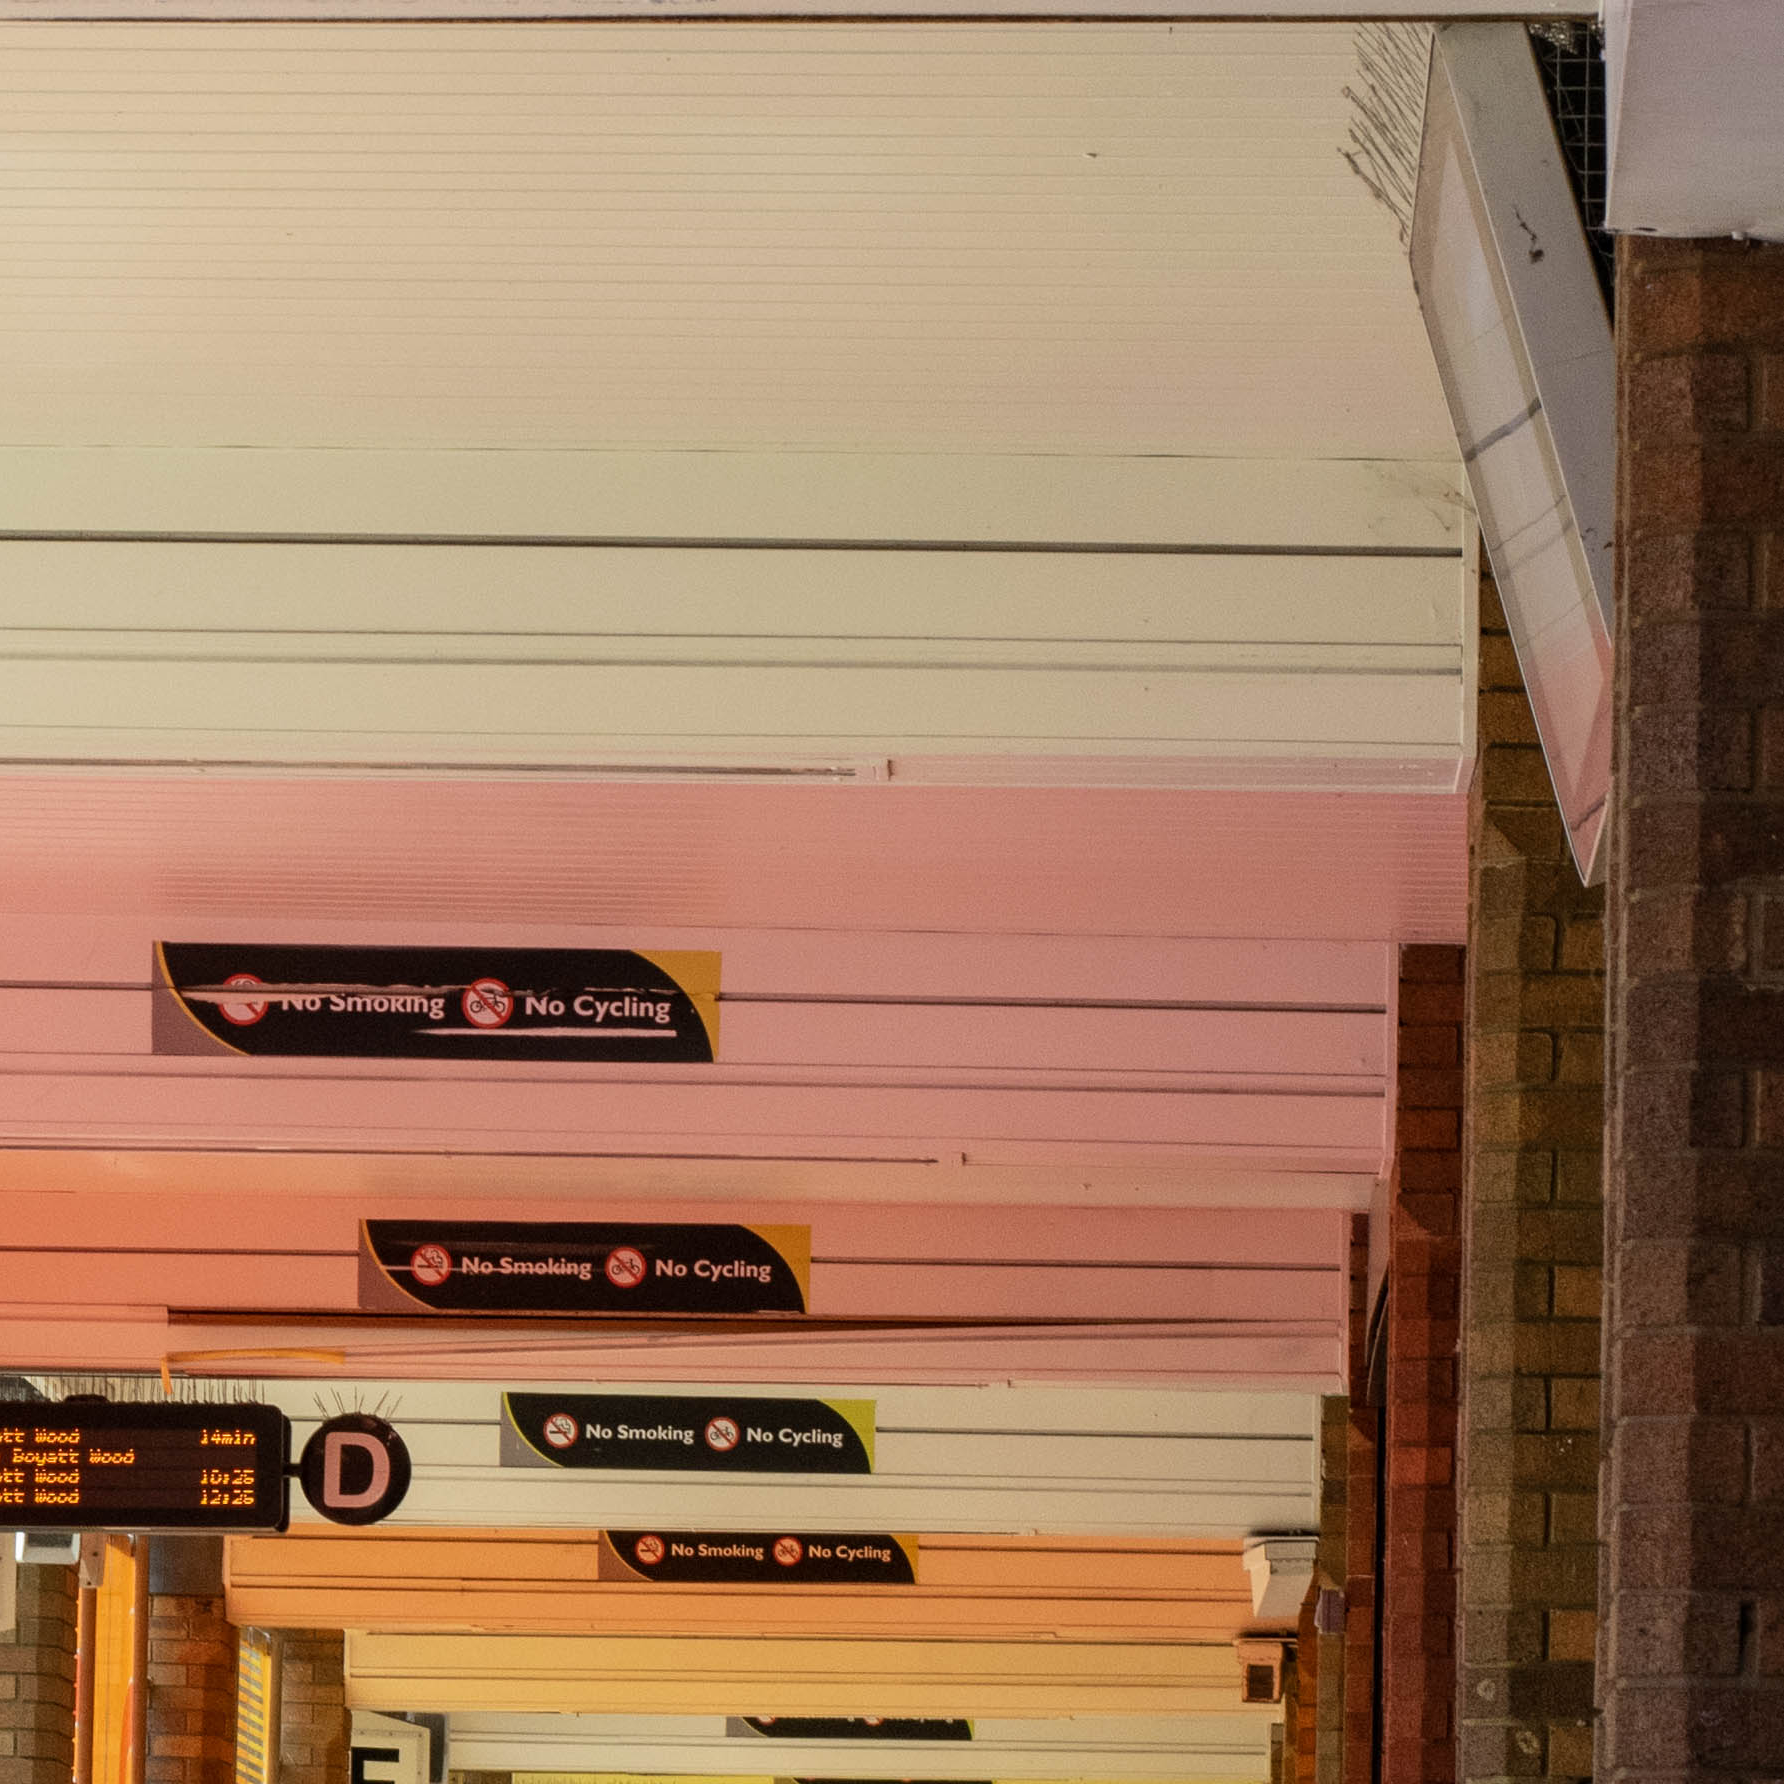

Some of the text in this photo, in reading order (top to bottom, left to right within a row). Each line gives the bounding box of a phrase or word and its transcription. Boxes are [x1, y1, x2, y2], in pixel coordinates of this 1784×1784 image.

[281, 993, 670, 1023] No Smoking No Cycling
[461, 1257, 771, 1282] No Smoking No Cycling
[35, 1429, 80, 1443] Wood
[201, 1429, 255, 1444] 14min
[586, 1424, 842, 1448] No Smoking No Cycling
[12, 1448, 79, 1466] Boyatt
[89, 1449, 135, 1464] Wood
[35, 1469, 80, 1483] Wood
[324, 1432, 390, 1508] D
[35, 1489, 79, 1504] Wood
[672, 1544, 890, 1561] No Smoking No Cycling
